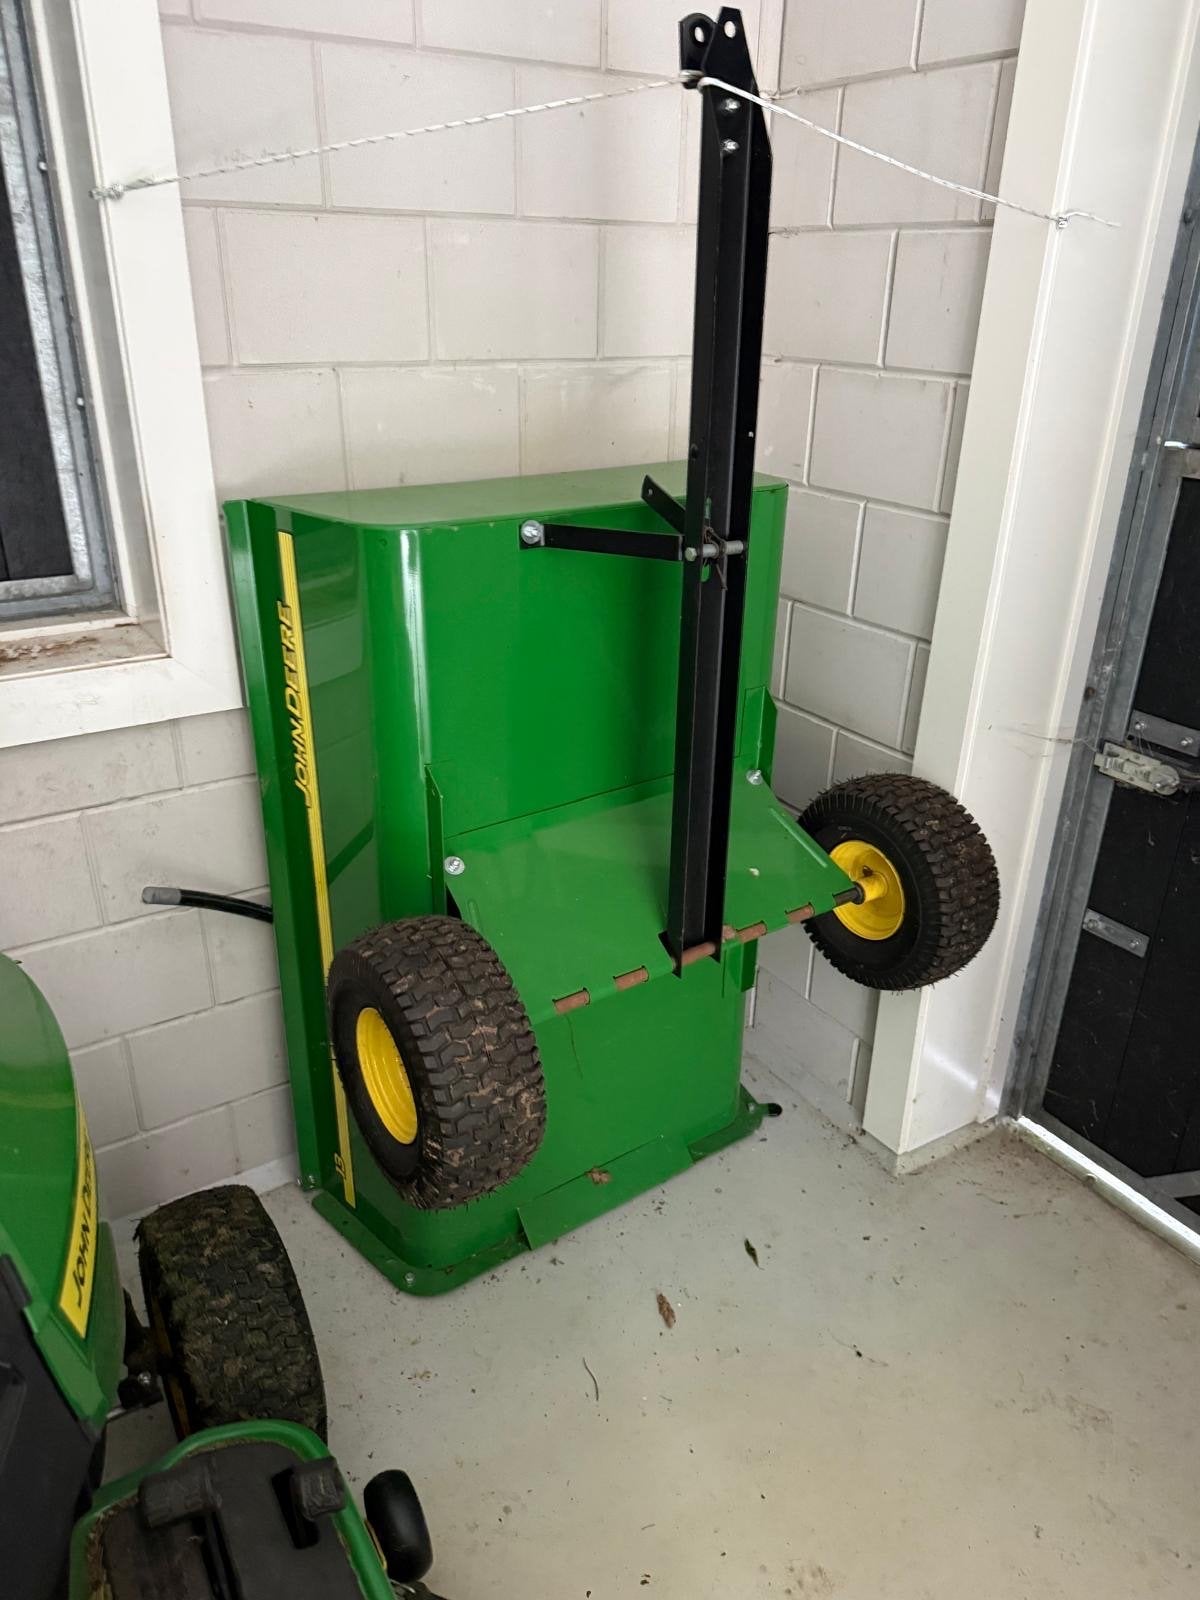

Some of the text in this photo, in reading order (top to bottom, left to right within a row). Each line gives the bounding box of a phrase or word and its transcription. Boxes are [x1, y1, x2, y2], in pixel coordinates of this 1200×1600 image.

[277, 600, 312, 808] JOHN DEERE
[73, 1212, 90, 1310] JOHN
